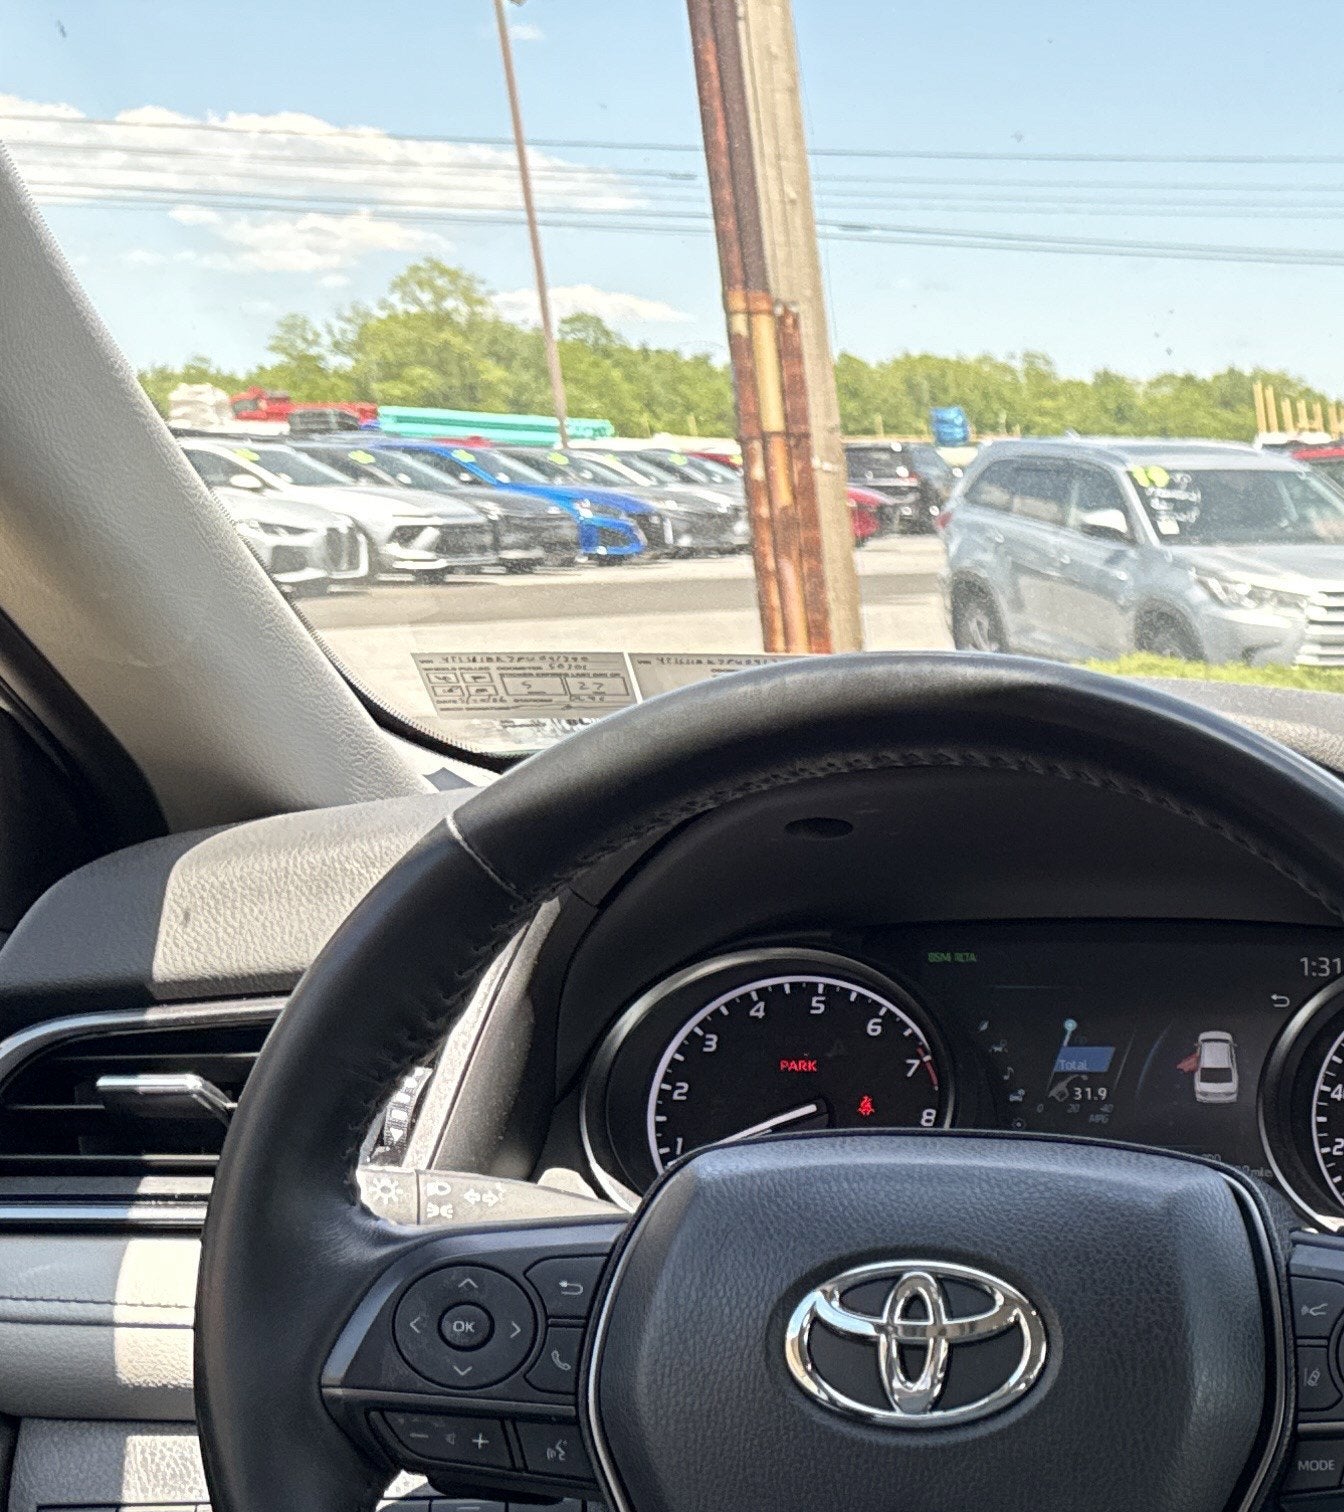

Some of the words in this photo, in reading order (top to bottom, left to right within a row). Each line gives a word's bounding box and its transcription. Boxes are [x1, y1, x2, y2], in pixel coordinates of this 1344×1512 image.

[1300, 957, 1342, 977] 1:31
[749, 1001, 765, 1019] 4
[810, 996, 826, 1014] 5
[866, 1018, 882, 1036] 6
[703, 1034, 719, 1052] 3
[779, 1060, 817, 1072] PARK
[906, 1059, 921, 1077] 7
[1060, 1060, 1088, 1071] Total
[672, 1082, 689, 1100] 2
[1073, 1087, 1107, 1100] 31.9
[920, 1109, 936, 1127] 8
[675, 1138, 683, 1155] 1
[453, 1320, 475, 1333] OK
[1298, 1460, 1335, 1471] MODE
